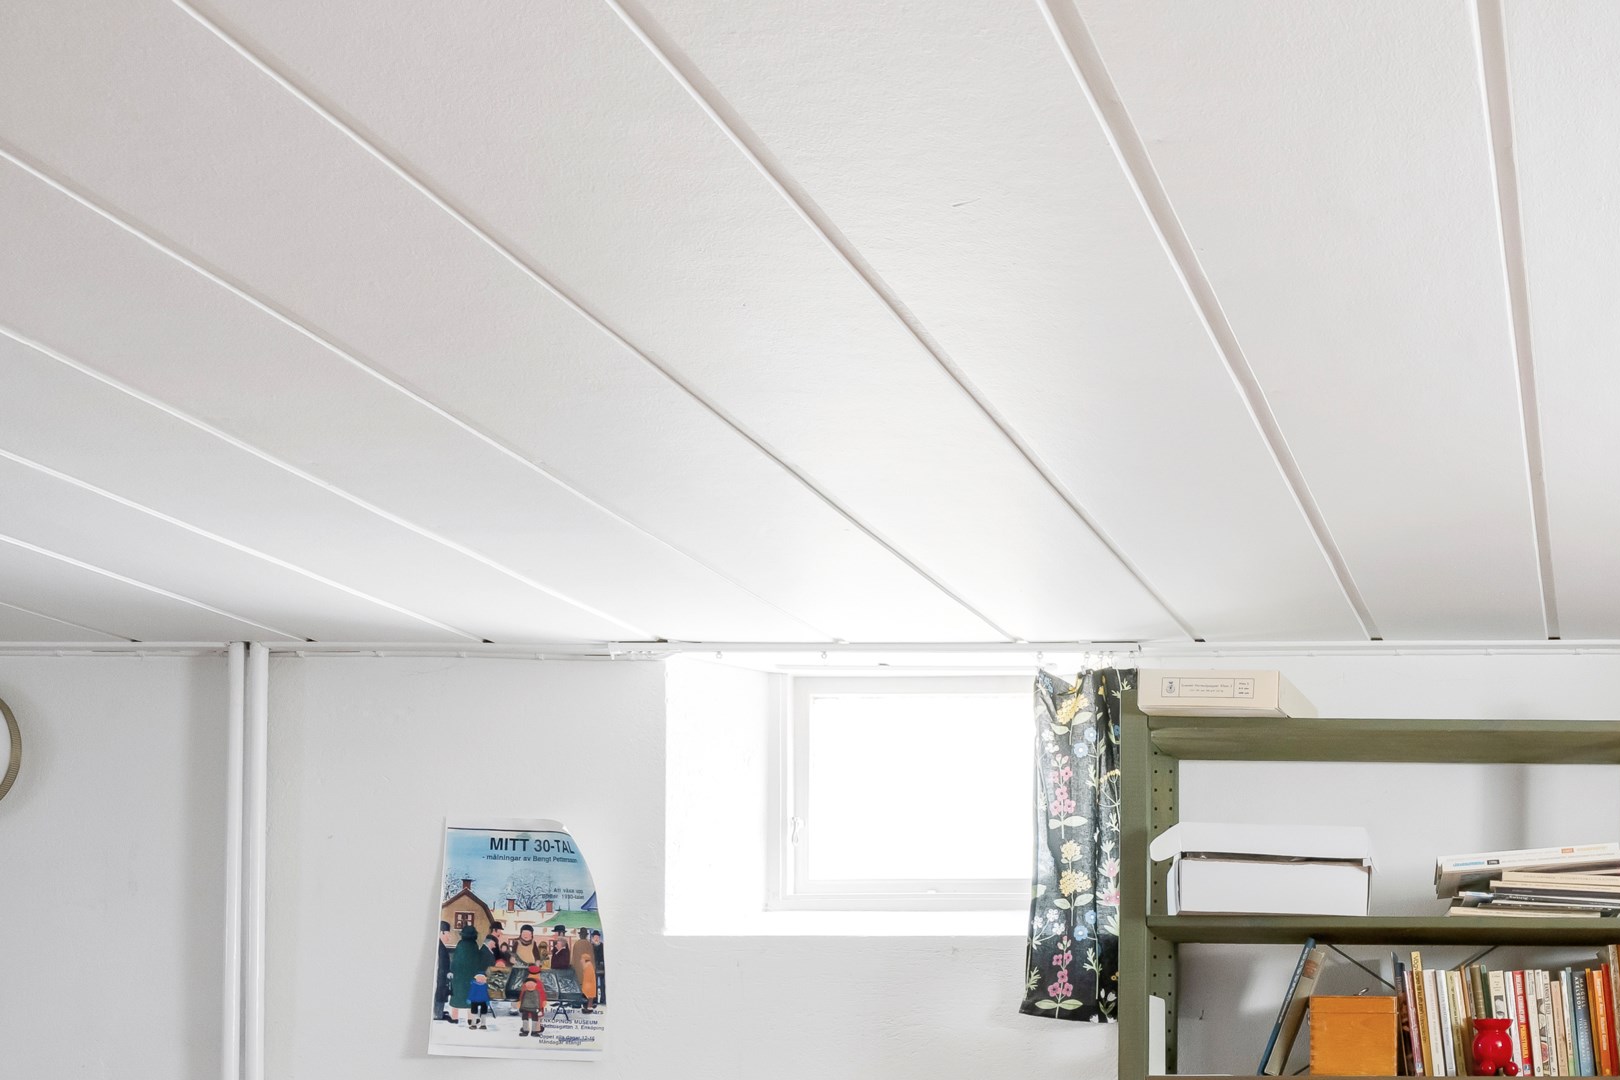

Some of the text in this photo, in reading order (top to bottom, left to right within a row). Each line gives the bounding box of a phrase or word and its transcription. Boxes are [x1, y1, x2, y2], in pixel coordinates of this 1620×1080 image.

[490, 837, 575, 854] MITT 30-TAL
[486, 854, 521, 862] målningar
[1574, 976, 1582, 1010] AXELSSON
